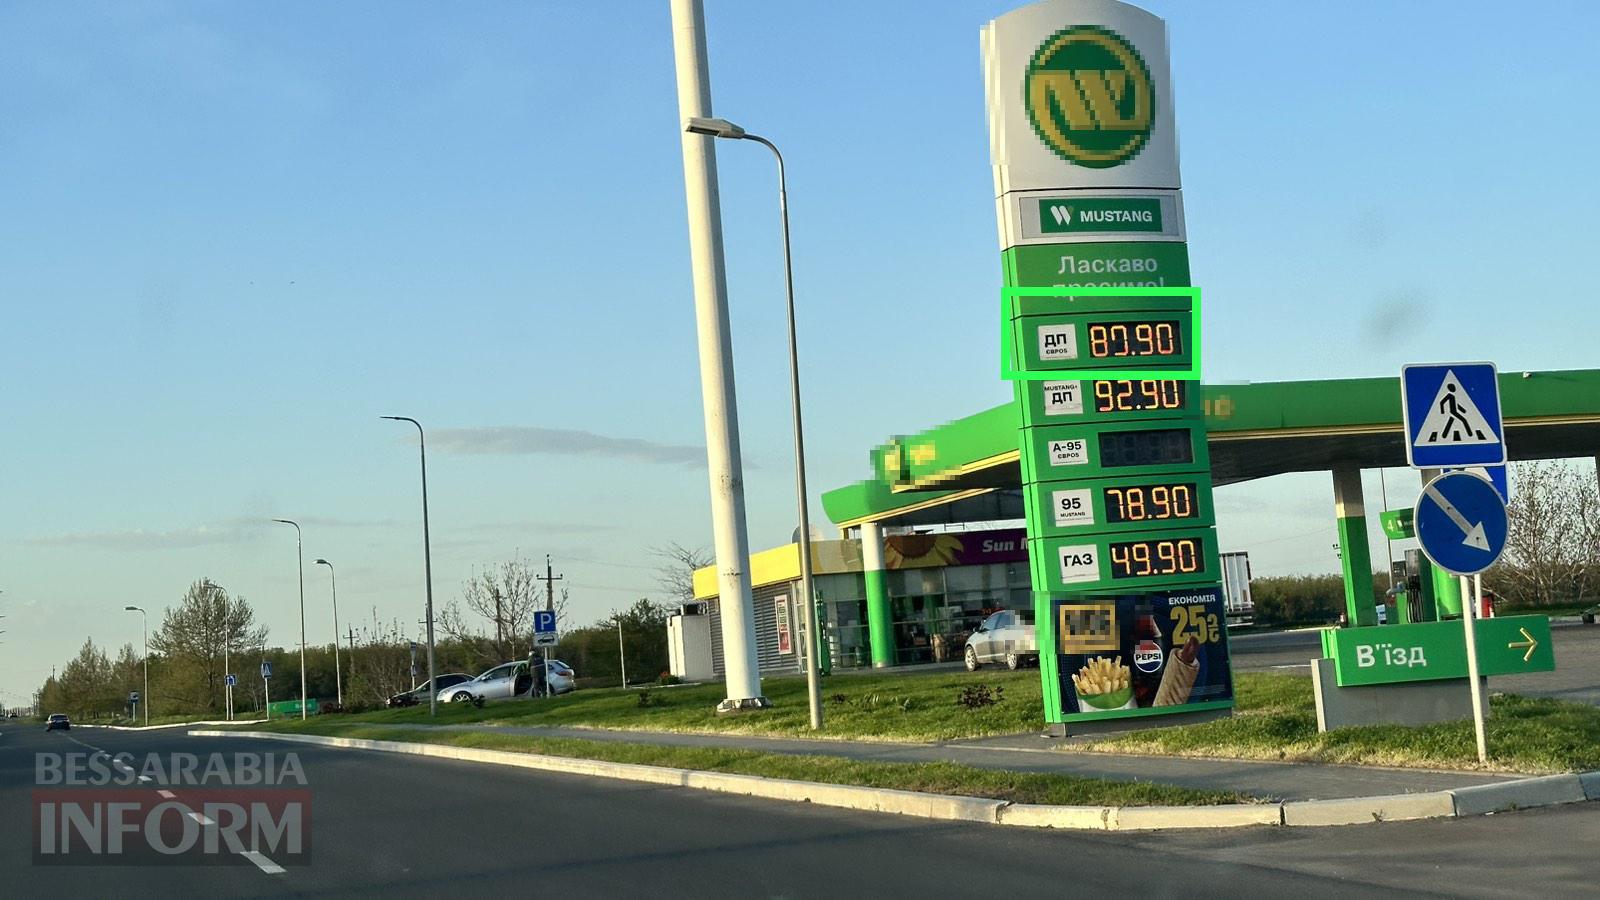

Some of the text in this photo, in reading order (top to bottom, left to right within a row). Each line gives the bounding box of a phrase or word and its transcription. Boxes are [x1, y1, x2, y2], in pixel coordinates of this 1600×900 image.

[1079, 210, 1153, 222] MUSTANG
[1058, 255, 1158, 274] Ласкаво
[1045, 334, 1067, 347] ДП
[1052, 391, 1073, 404] ДП
[1095, 380, 1179, 412] 92.90
[1061, 497, 1081, 510] 95
[1107, 486, 1190, 520] 78.90
[982, 540, 1014, 552] Sun
[1063, 553, 1093, 567] ГАЗ
[1111, 540, 1197, 575] 49.90
[1168, 594, 1216, 605] ЕКОНОМІЯ
[540, 613, 552, 630] P
